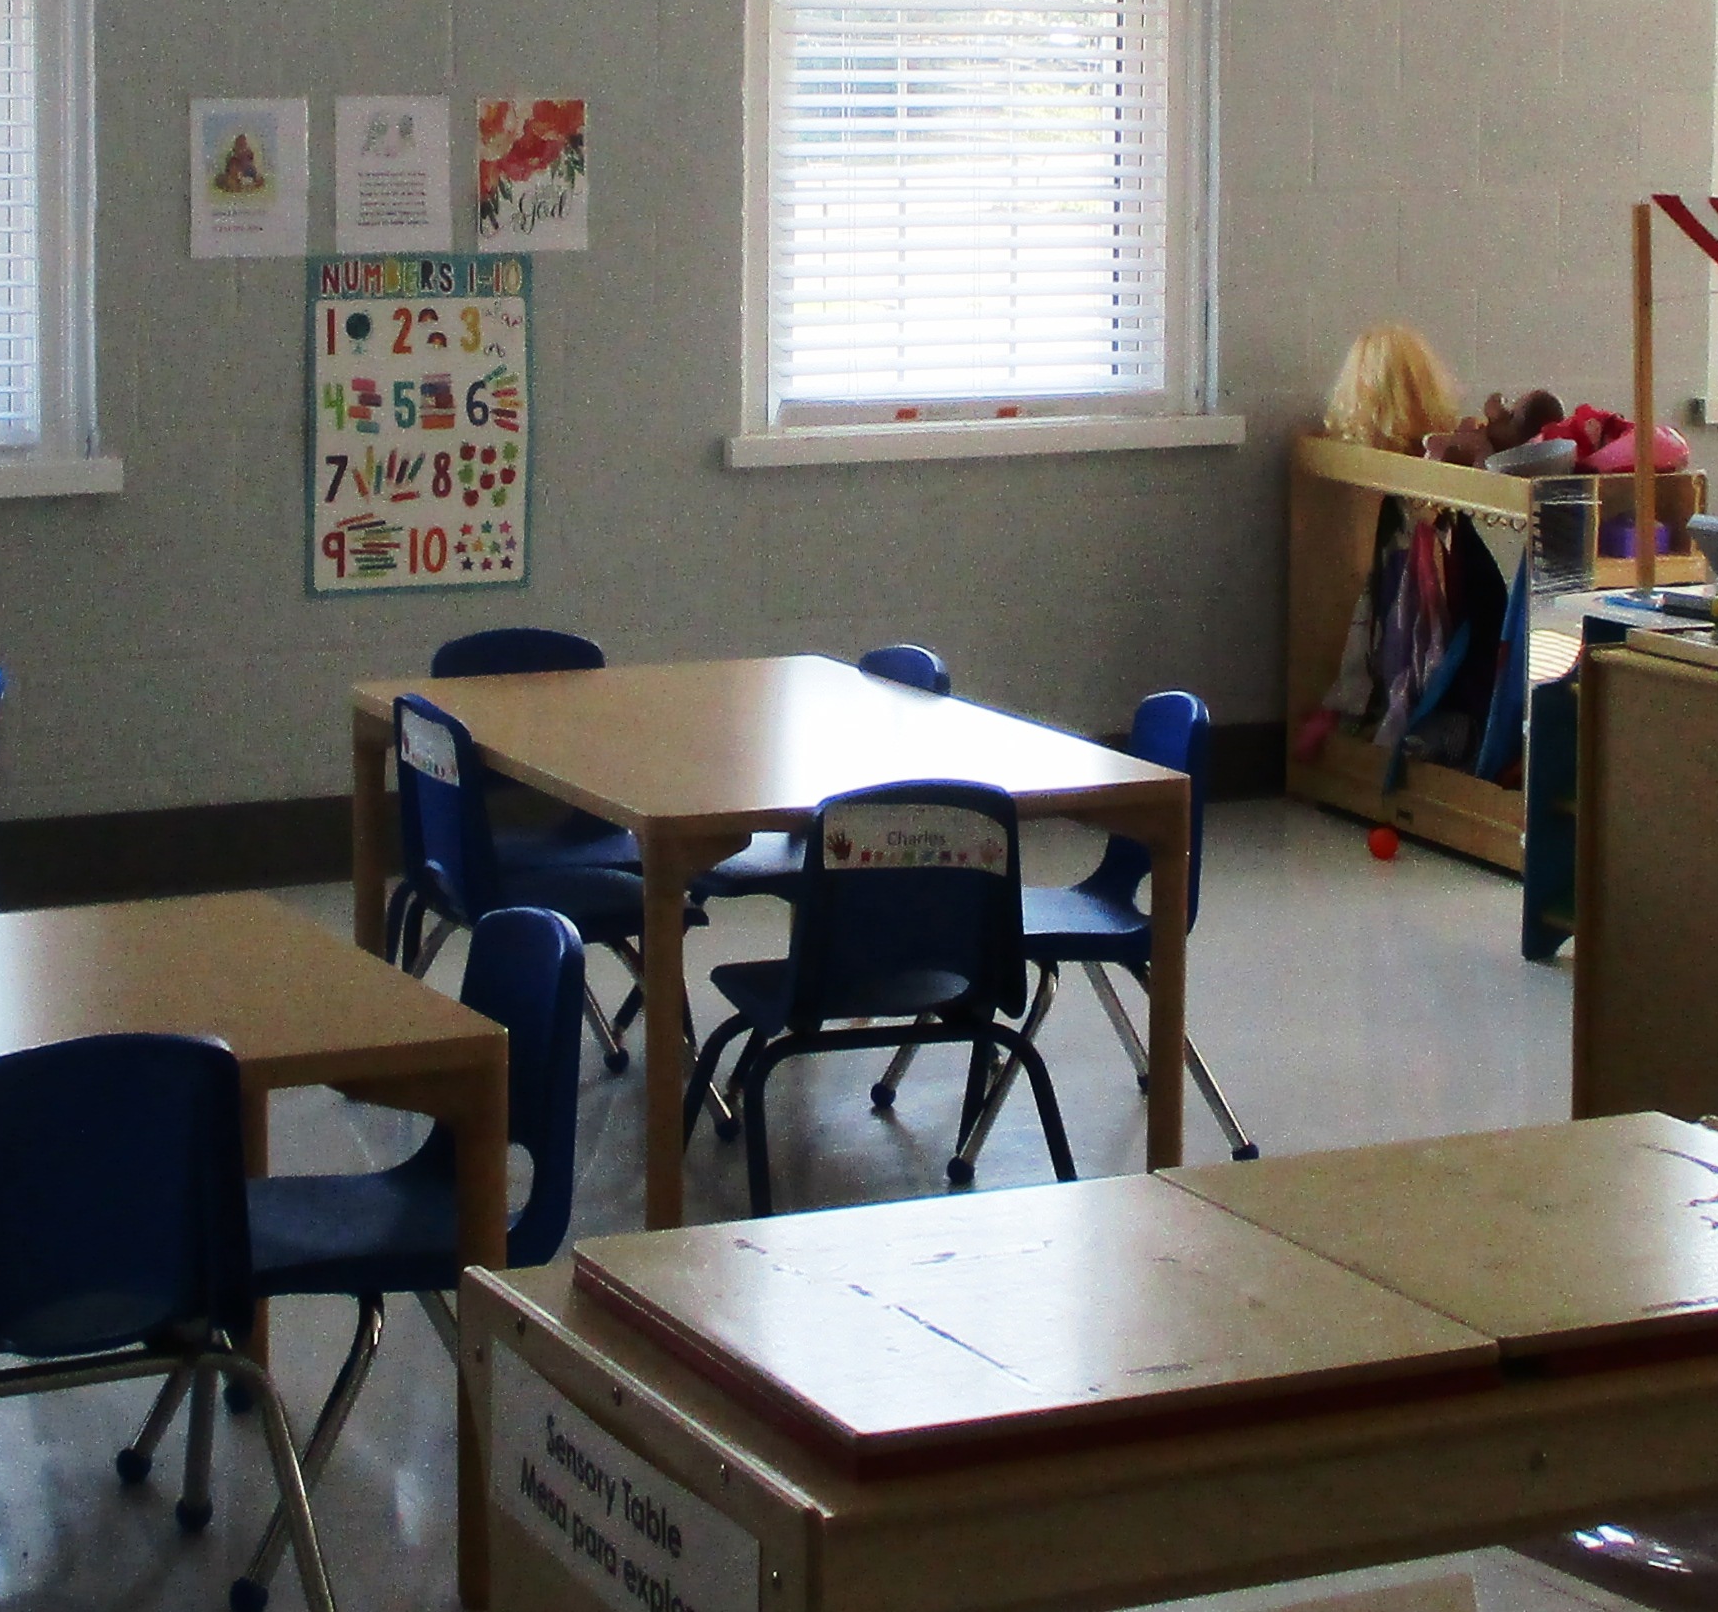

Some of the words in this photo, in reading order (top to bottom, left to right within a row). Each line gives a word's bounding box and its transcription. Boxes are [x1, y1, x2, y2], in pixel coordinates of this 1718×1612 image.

[321, 258, 454, 295] NUMBERS
[327, 308, 336, 355] 1
[392, 307, 412, 354] 2
[460, 306, 481, 353] 3
[323, 383, 344, 430] 4
[393, 381, 416, 428] 5
[465, 380, 489, 426] 6
[325, 455, 348, 503] 7
[432, 451, 452, 498] 8
[322, 530, 345, 578] 9
[409, 526, 447, 574] 10
[887, 830, 946, 847] Charles
[546, 1414, 616, 1517] Sensory
[622, 1477, 682, 1558] Table
[519, 1456, 566, 1531] Mesa
[573, 1511, 616, 1577] para
